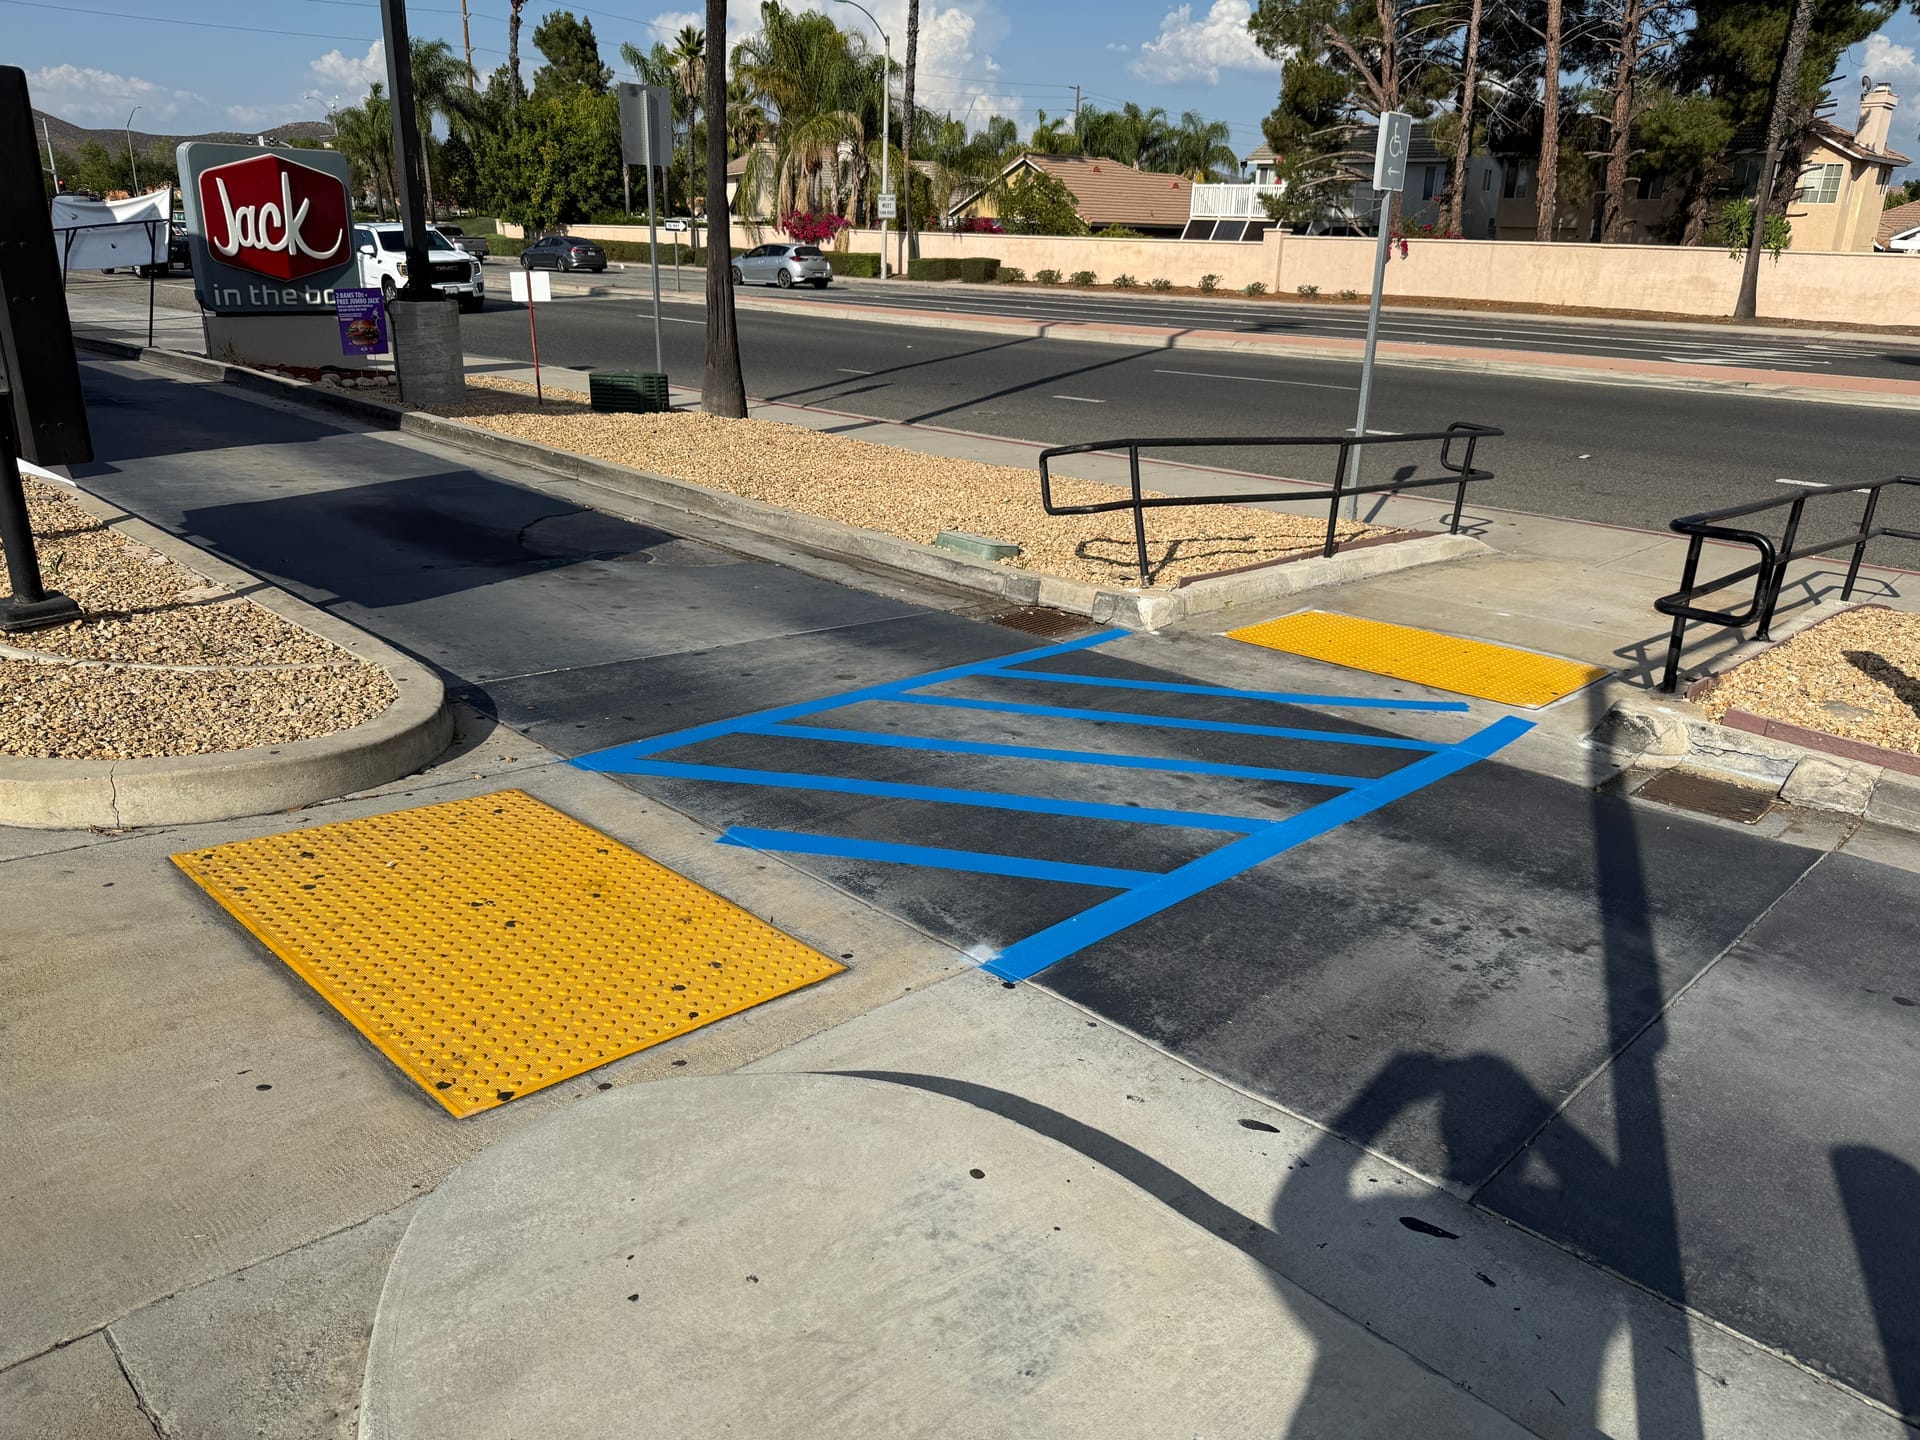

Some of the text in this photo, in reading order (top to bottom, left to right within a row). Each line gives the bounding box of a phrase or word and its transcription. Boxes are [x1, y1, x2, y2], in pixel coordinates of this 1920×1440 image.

[213, 171, 343, 260] Jack
[213, 283, 336, 306] in the bo
